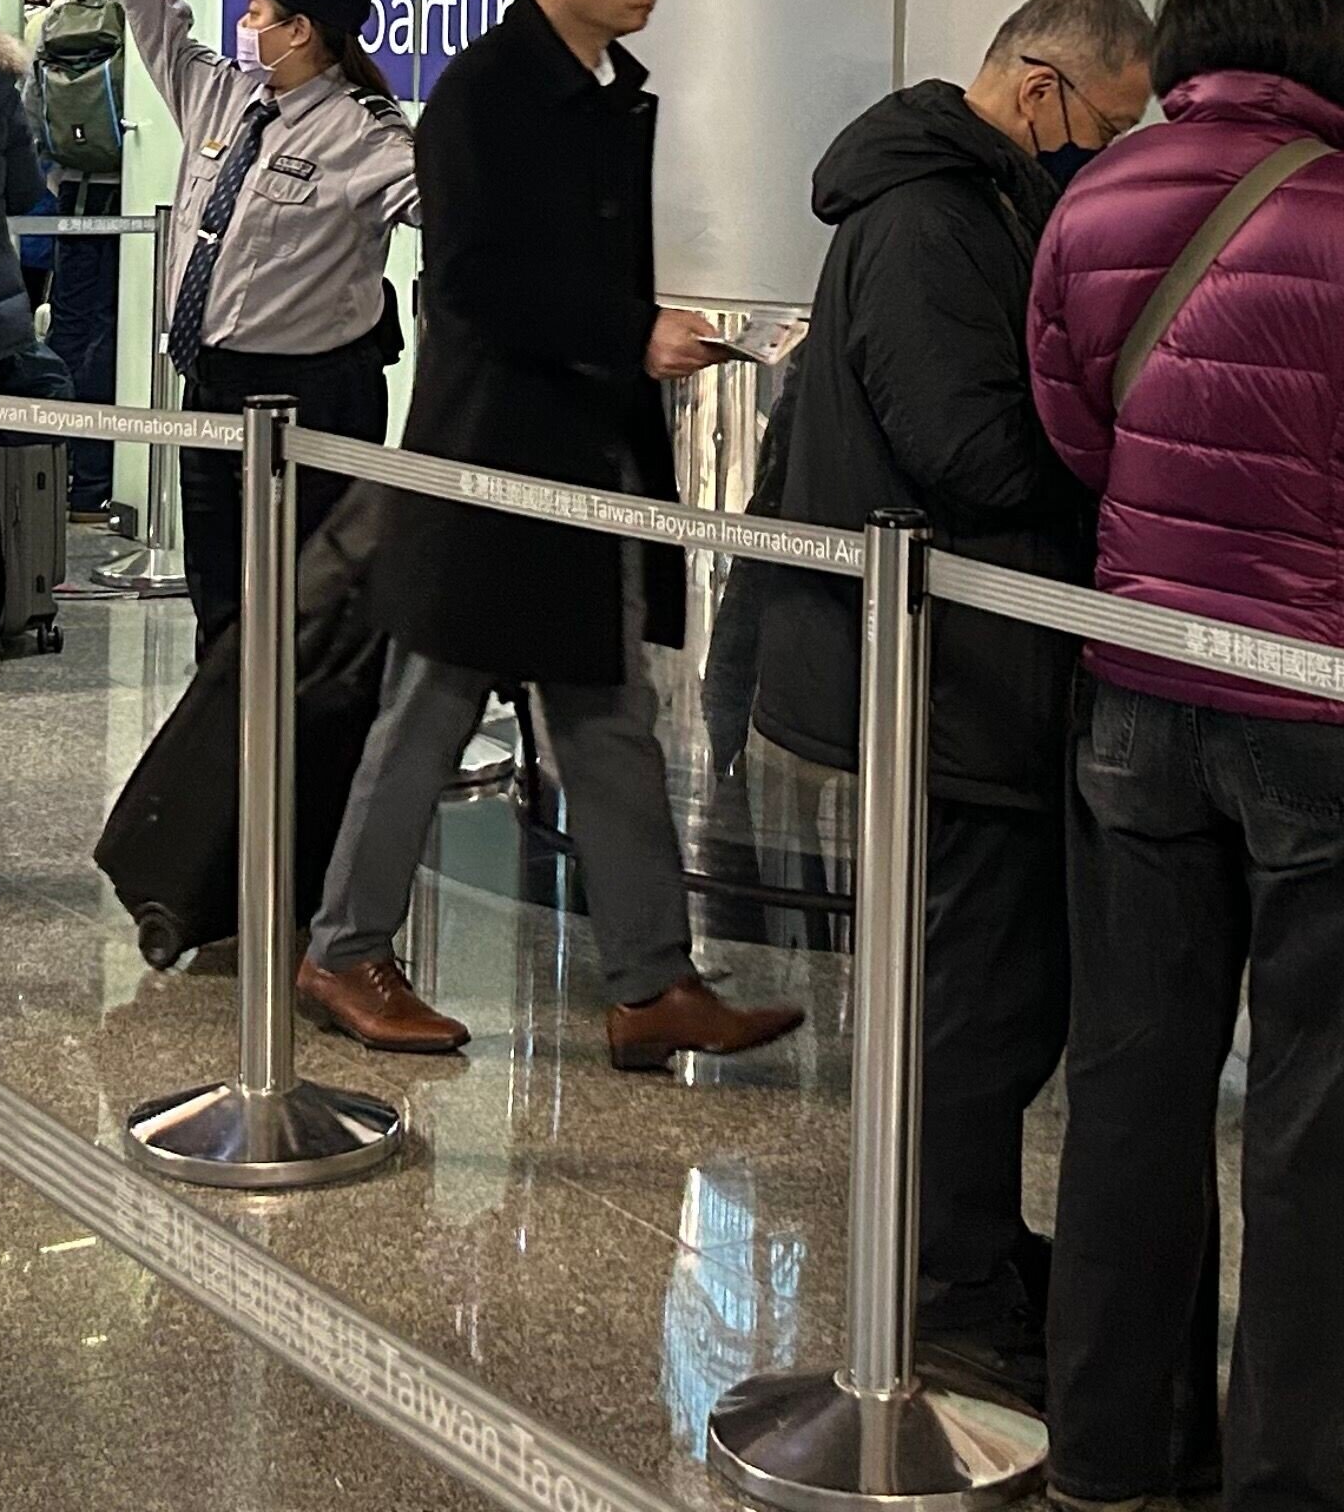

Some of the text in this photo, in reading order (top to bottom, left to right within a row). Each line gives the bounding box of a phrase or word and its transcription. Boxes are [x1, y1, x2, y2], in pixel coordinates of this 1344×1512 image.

[31, 404, 95, 433] Taoyuan
[98, 412, 199, 439] International
[590, 495, 645, 527] Taiwan
[648, 505, 717, 542] Taoyuan
[720, 519, 831, 562] International
[379, 1339, 501, 1472] Taiwan
